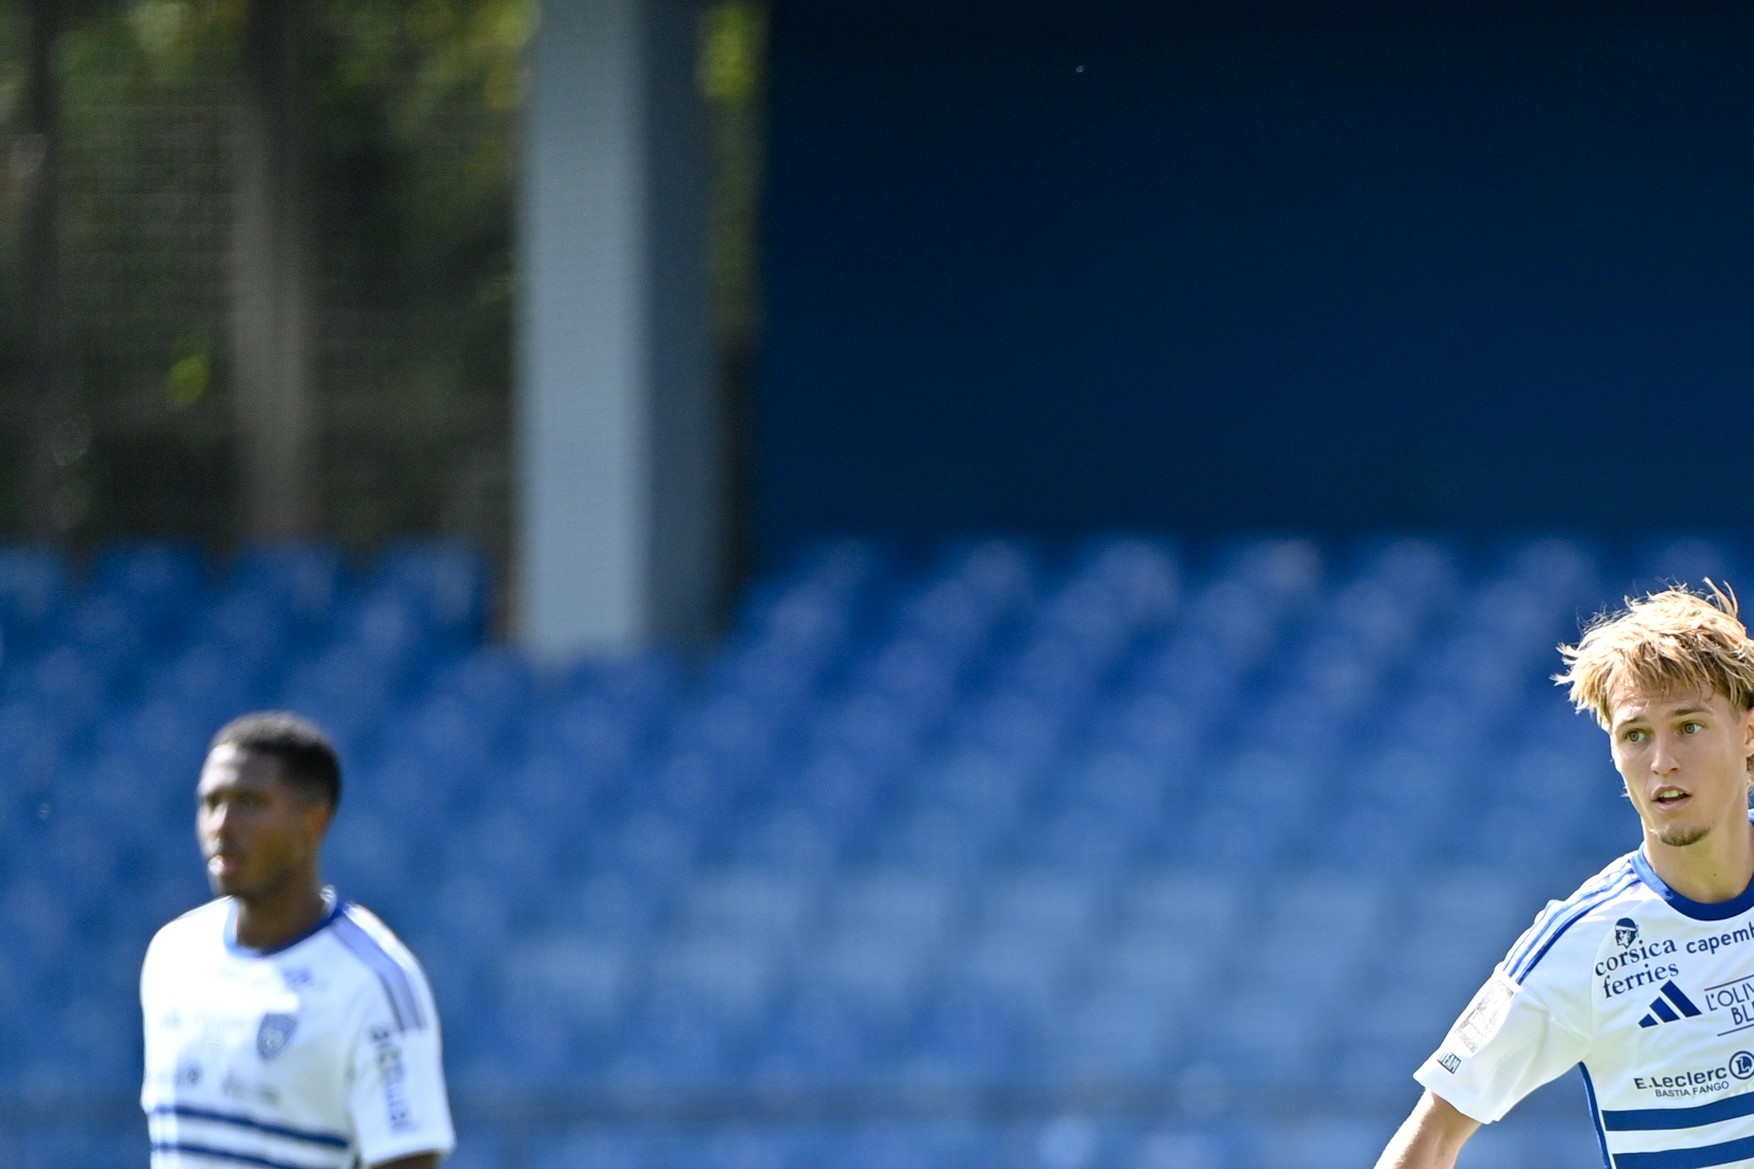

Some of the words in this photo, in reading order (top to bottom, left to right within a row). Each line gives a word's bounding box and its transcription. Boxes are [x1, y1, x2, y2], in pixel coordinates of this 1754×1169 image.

[1595, 938, 1677, 976] corsica
[1602, 962, 1679, 999] ferries
[1634, 1066, 1728, 1090] E.Leclerc
[1655, 1087, 1690, 1098] BASTIA
[1693, 1080, 1729, 1096] FANGO
